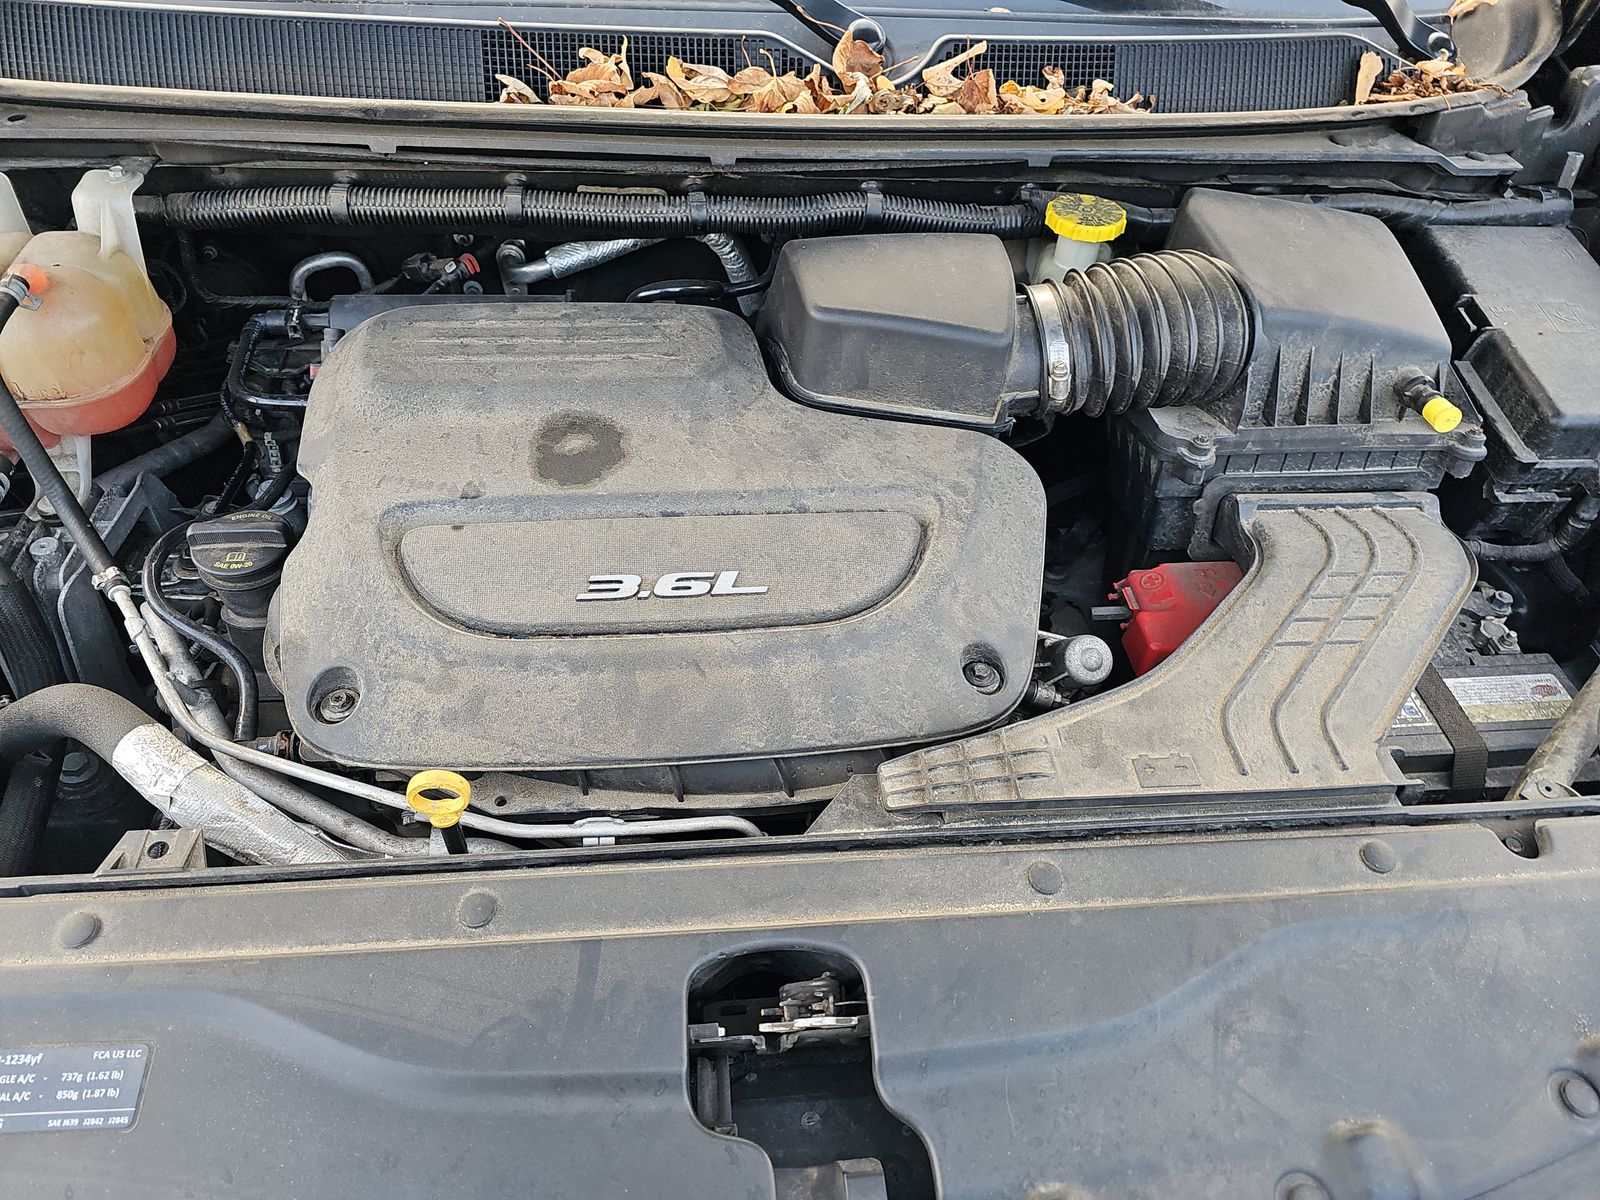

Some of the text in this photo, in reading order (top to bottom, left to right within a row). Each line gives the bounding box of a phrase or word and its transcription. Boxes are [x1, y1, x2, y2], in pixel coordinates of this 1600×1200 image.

[231, 512, 260, 520] ENGINE
[213, 561, 230, 569] SAE
[575, 570, 769, 602] 3.6L
[0, 1052, 44, 1066] -1234yf
[93, 1049, 142, 1061] FCA US LLC
[17, 1073, 36, 1085] A/C
[61, 1072, 83, 1083] 737g
[86, 1070, 110, 1082] (1.62
[111, 1069, 124, 1081] lb)
[12, 1091, 31, 1103] A/C
[56, 1089, 79, 1101] 850g
[82, 1088, 105, 1100] (1.87
[107, 1088, 120, 1099] lb)
[47, 1119, 60, 1128] SAE
